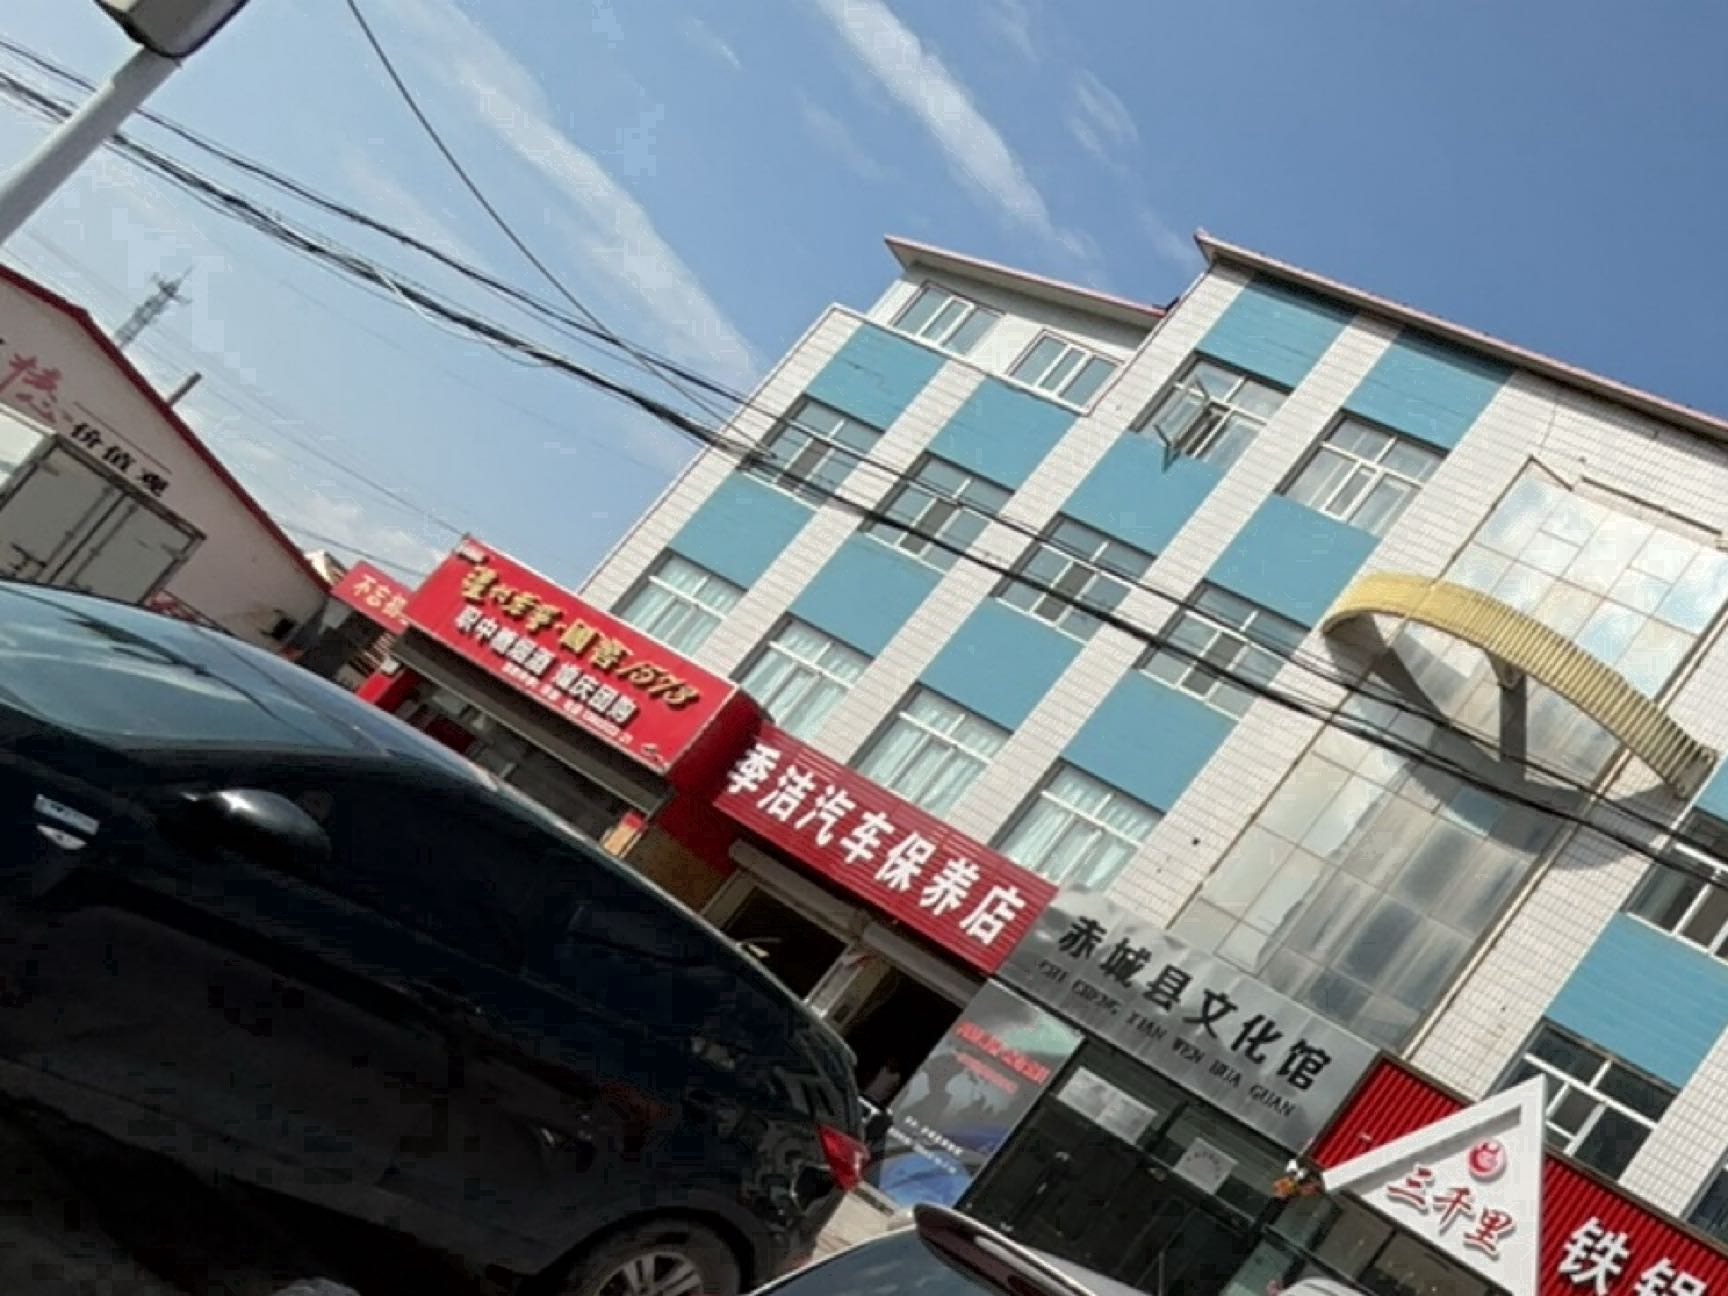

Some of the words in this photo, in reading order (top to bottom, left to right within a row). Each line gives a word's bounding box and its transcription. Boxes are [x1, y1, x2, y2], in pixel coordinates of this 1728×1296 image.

[727, 742, 1025, 948] 季洁汽车保养店
[1058, 915, 1332, 1090] 赤城县文化馆
[1387, 1165, 1518, 1257] 三千里
